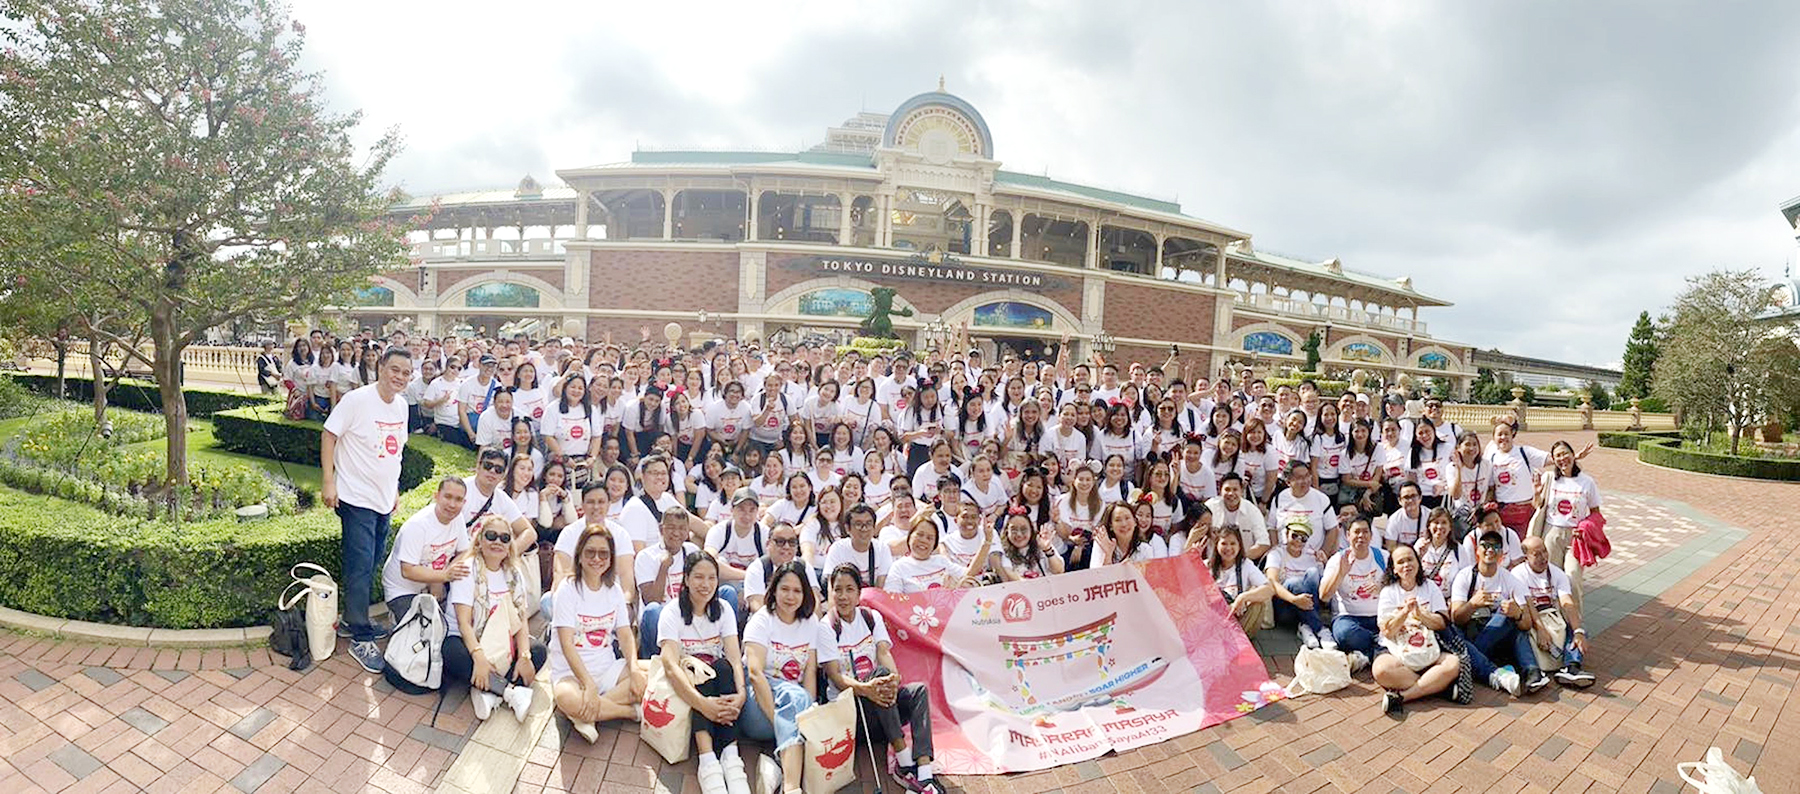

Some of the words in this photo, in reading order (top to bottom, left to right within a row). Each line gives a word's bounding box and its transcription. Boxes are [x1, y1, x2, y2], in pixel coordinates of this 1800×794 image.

[822, 260, 874, 273] TOKYO
[882, 264, 976, 282] DISNEYLAND
[982, 272, 1042, 286] STATION
[1037, 597, 1065, 611] goes
[1068, 593, 1080, 603] to
[1083, 579, 1139, 602] JAPAN
[1088, 681, 1115, 695] SOAR
[1115, 663, 1149, 685] HIGHER
[1103, 708, 1180, 734] MASAYA
